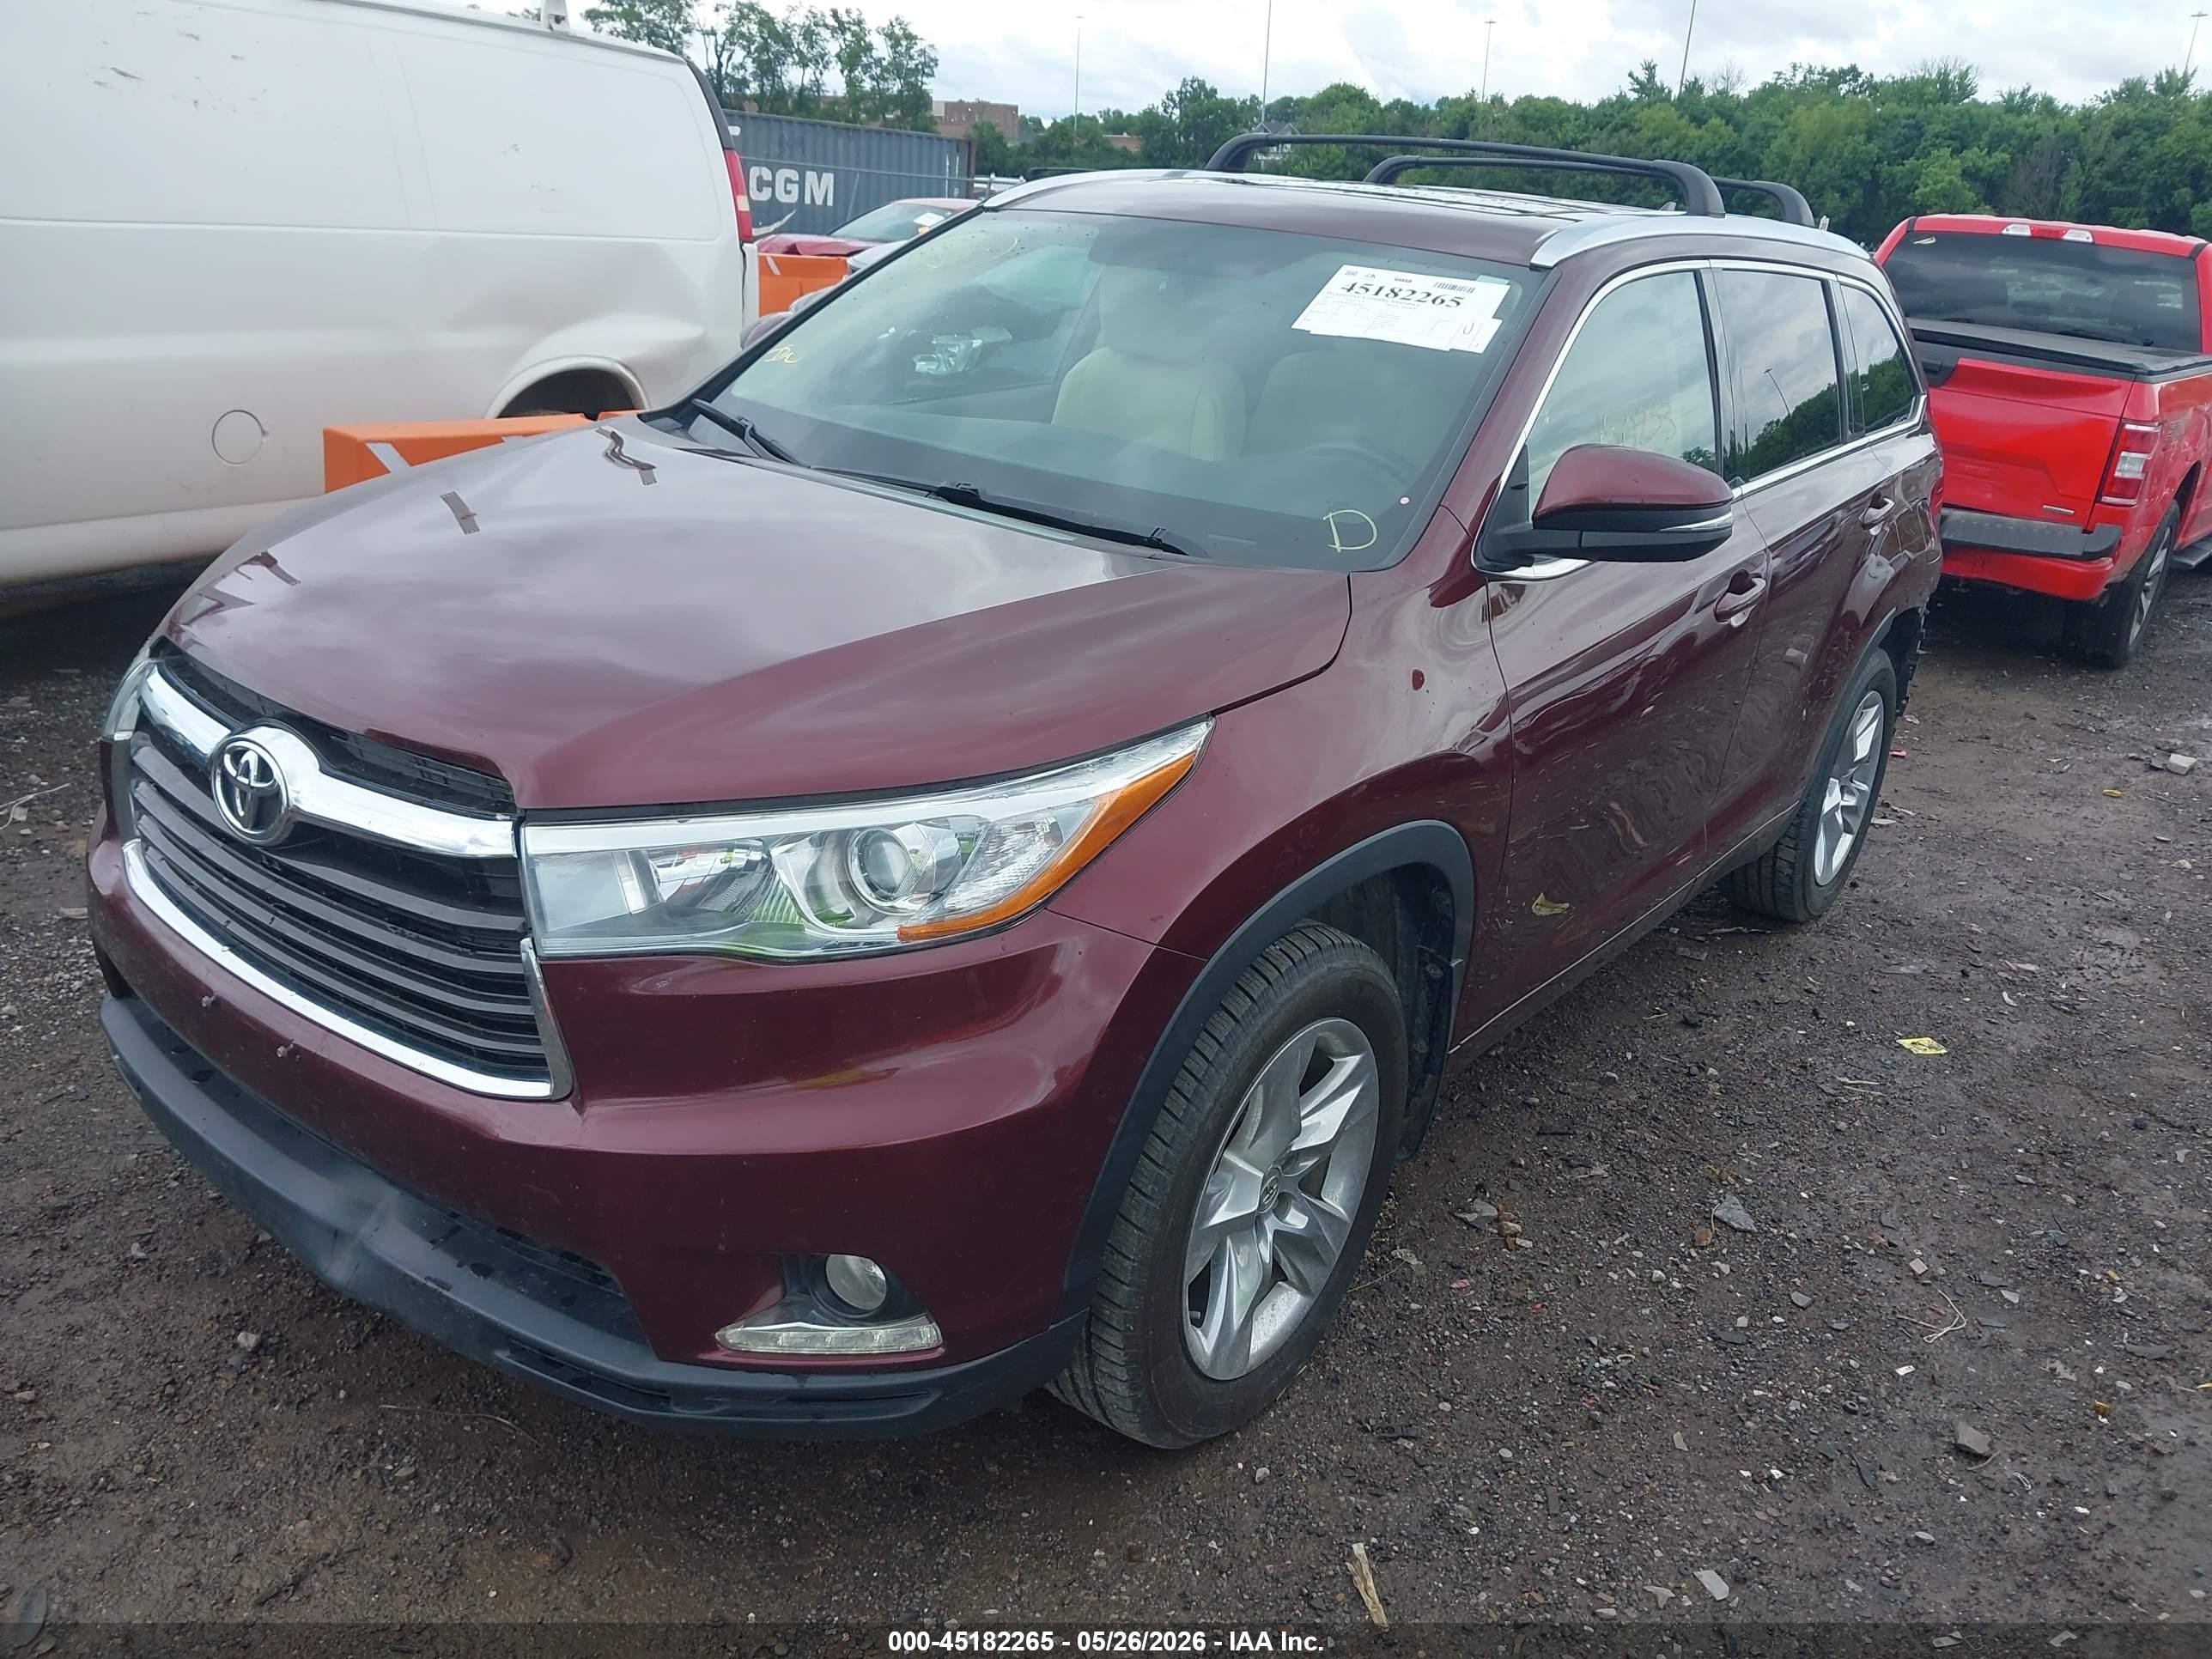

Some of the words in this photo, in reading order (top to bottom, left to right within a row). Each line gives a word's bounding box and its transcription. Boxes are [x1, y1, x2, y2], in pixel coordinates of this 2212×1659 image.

[749, 166, 835, 206] CGM
[1340, 281, 1465, 308] 45182265
[1322, 509, 1378, 553] D
